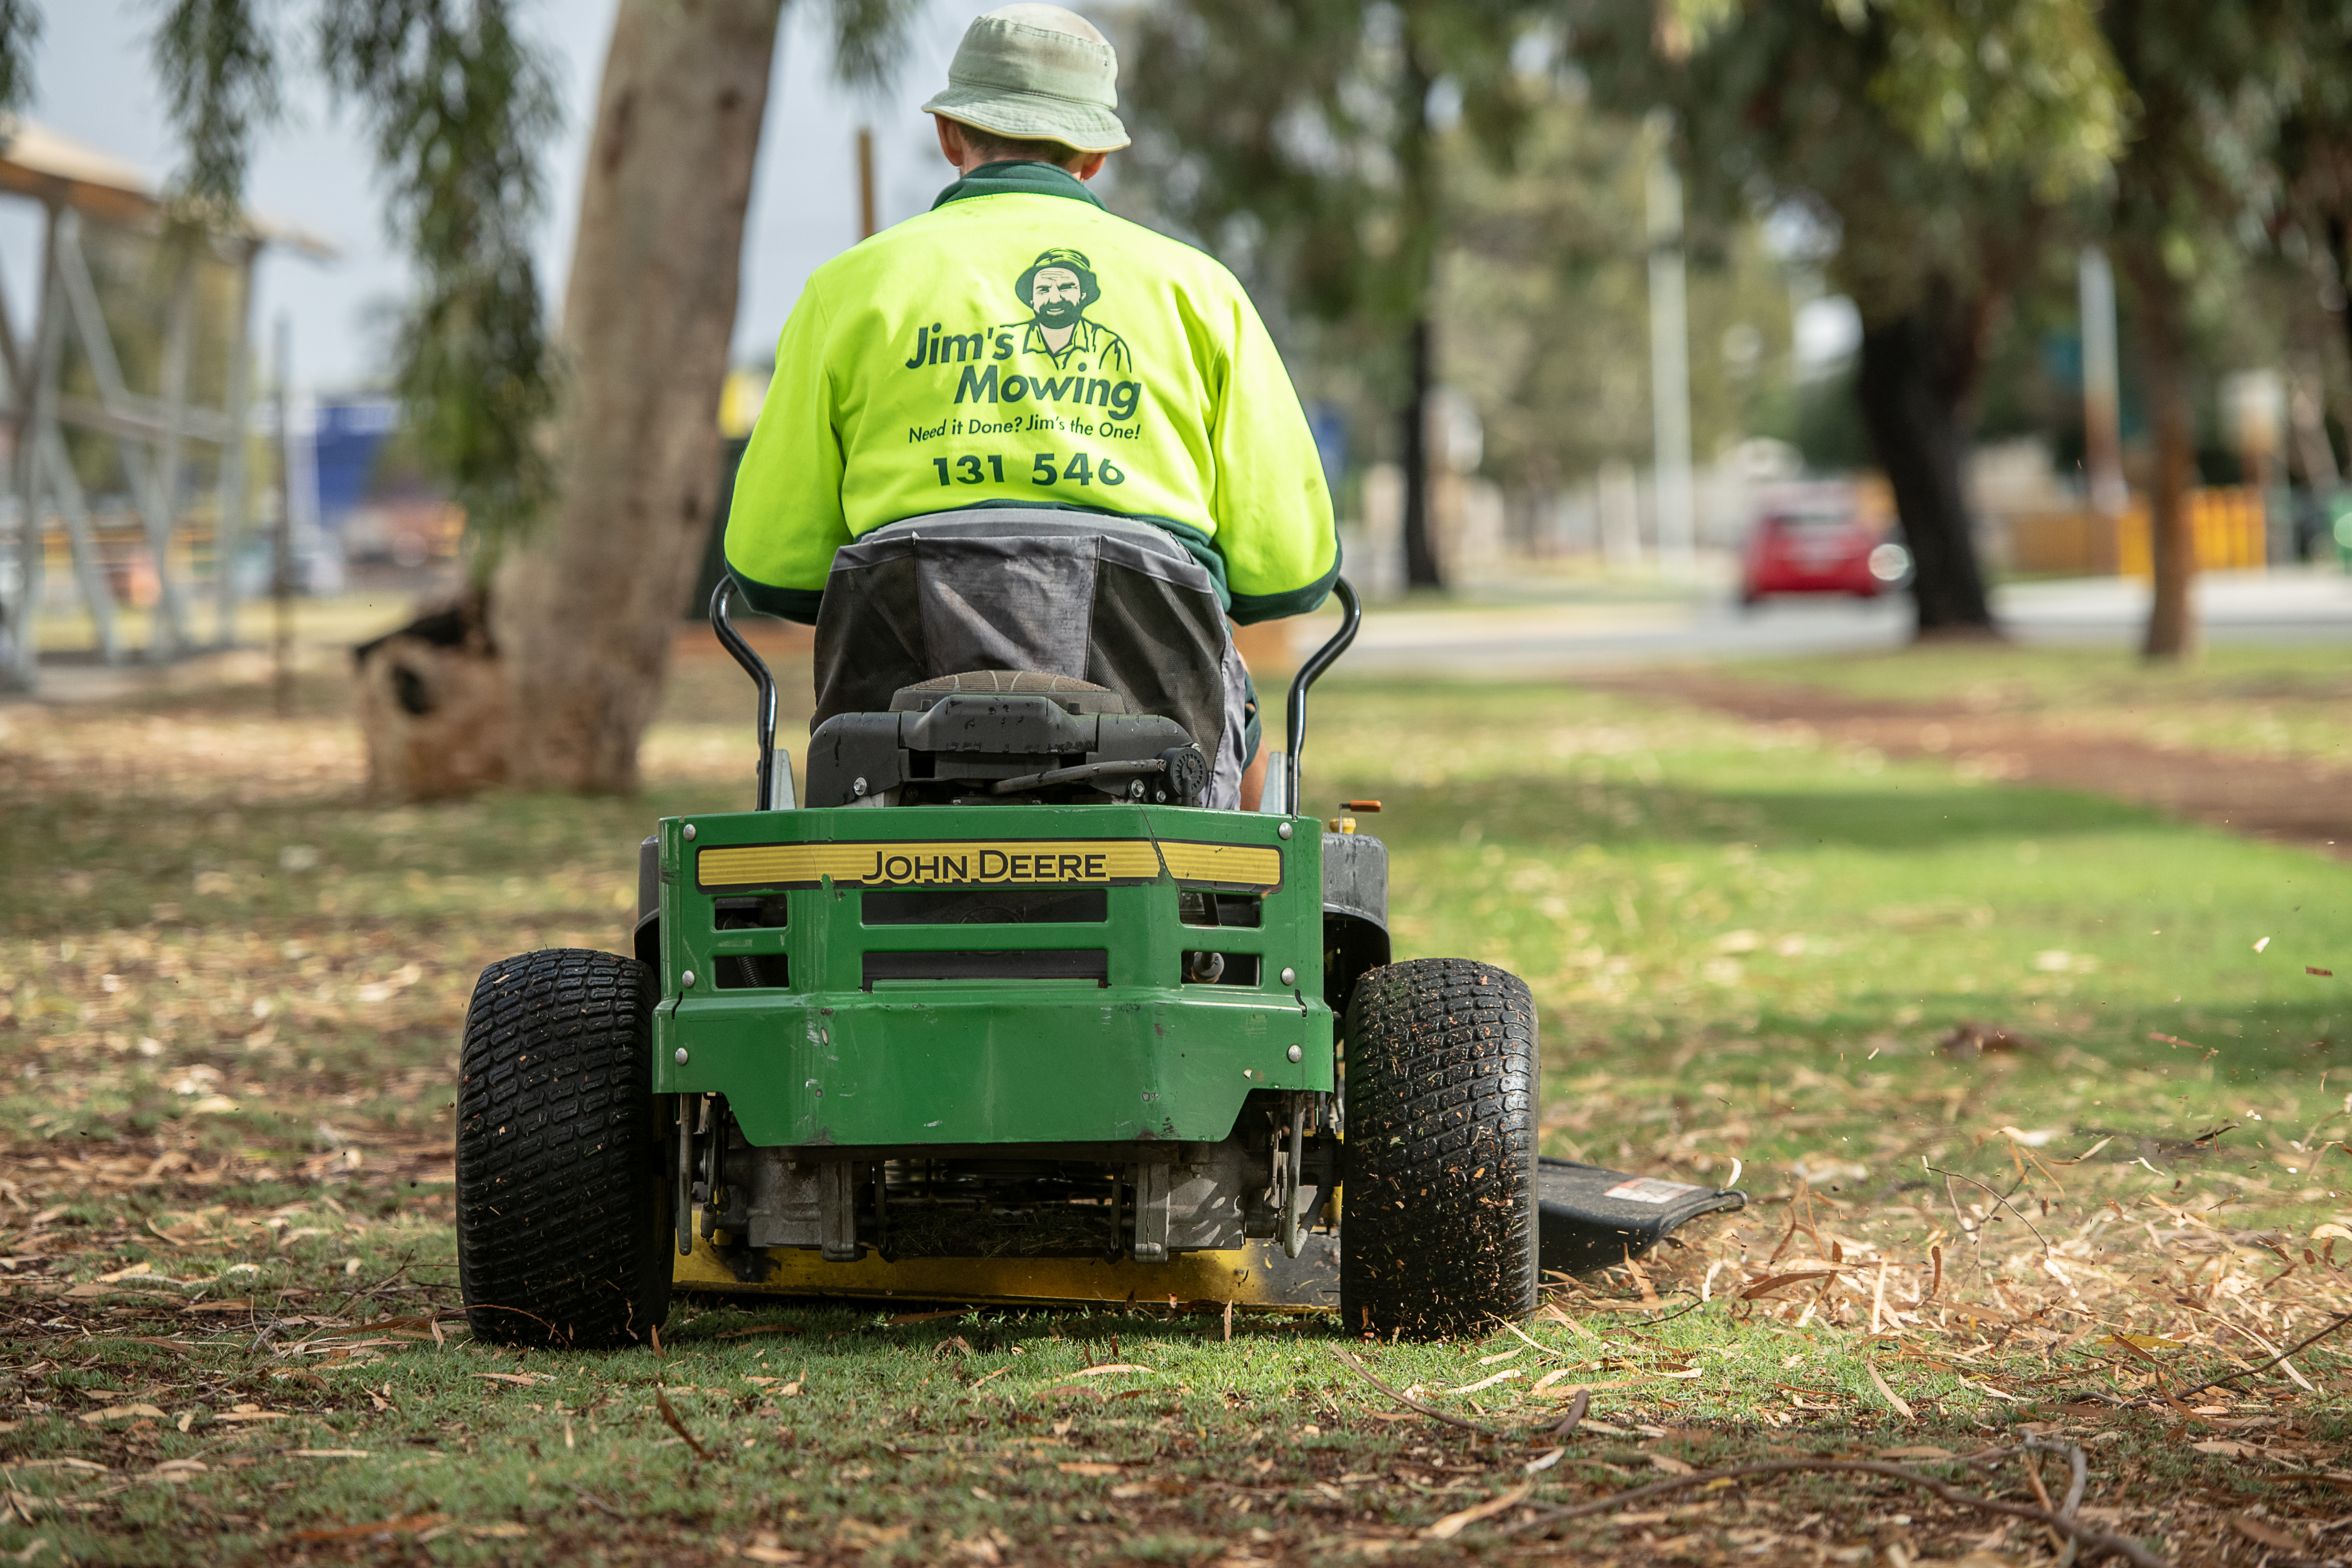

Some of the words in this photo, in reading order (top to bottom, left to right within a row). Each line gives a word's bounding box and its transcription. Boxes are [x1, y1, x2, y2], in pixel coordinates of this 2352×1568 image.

[905, 322, 1014, 369] Jim's
[953, 362, 1142, 421] Mowing
[909, 418, 947, 443] Need
[952, 418, 963, 435] it
[969, 416, 1023, 434] Done?
[1026, 414, 1065, 431] Jim's
[1070, 416, 1093, 435] the
[1099, 423, 1141, 439] One!
[933, 454, 1005, 487] 131
[1032, 452, 1125, 486] 546
[861, 850, 968, 880] JOHN
[979, 849, 1107, 879] DEERE
